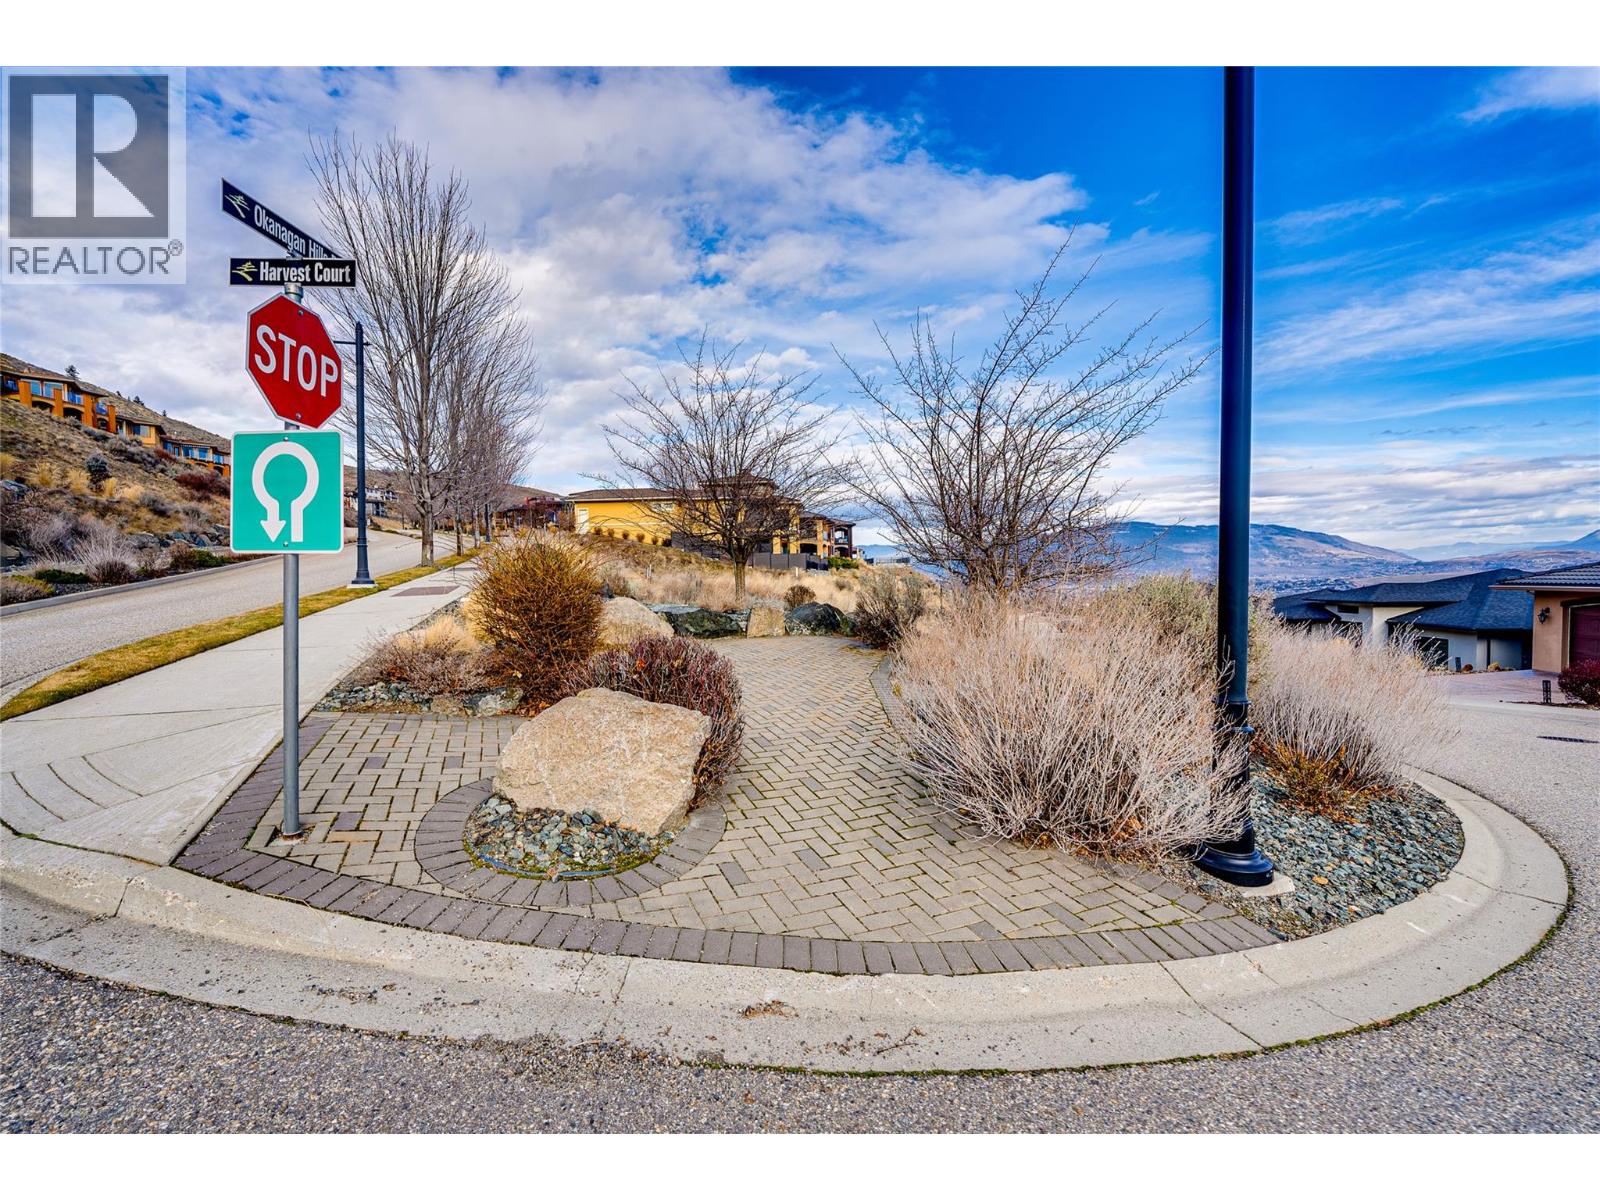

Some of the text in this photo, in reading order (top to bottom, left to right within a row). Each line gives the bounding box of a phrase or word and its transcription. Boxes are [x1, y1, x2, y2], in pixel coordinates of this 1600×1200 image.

[254, 204, 306, 255] Okanagan
[259, 261, 351, 282] Harvest Court
[254, 324, 339, 397] STOP
